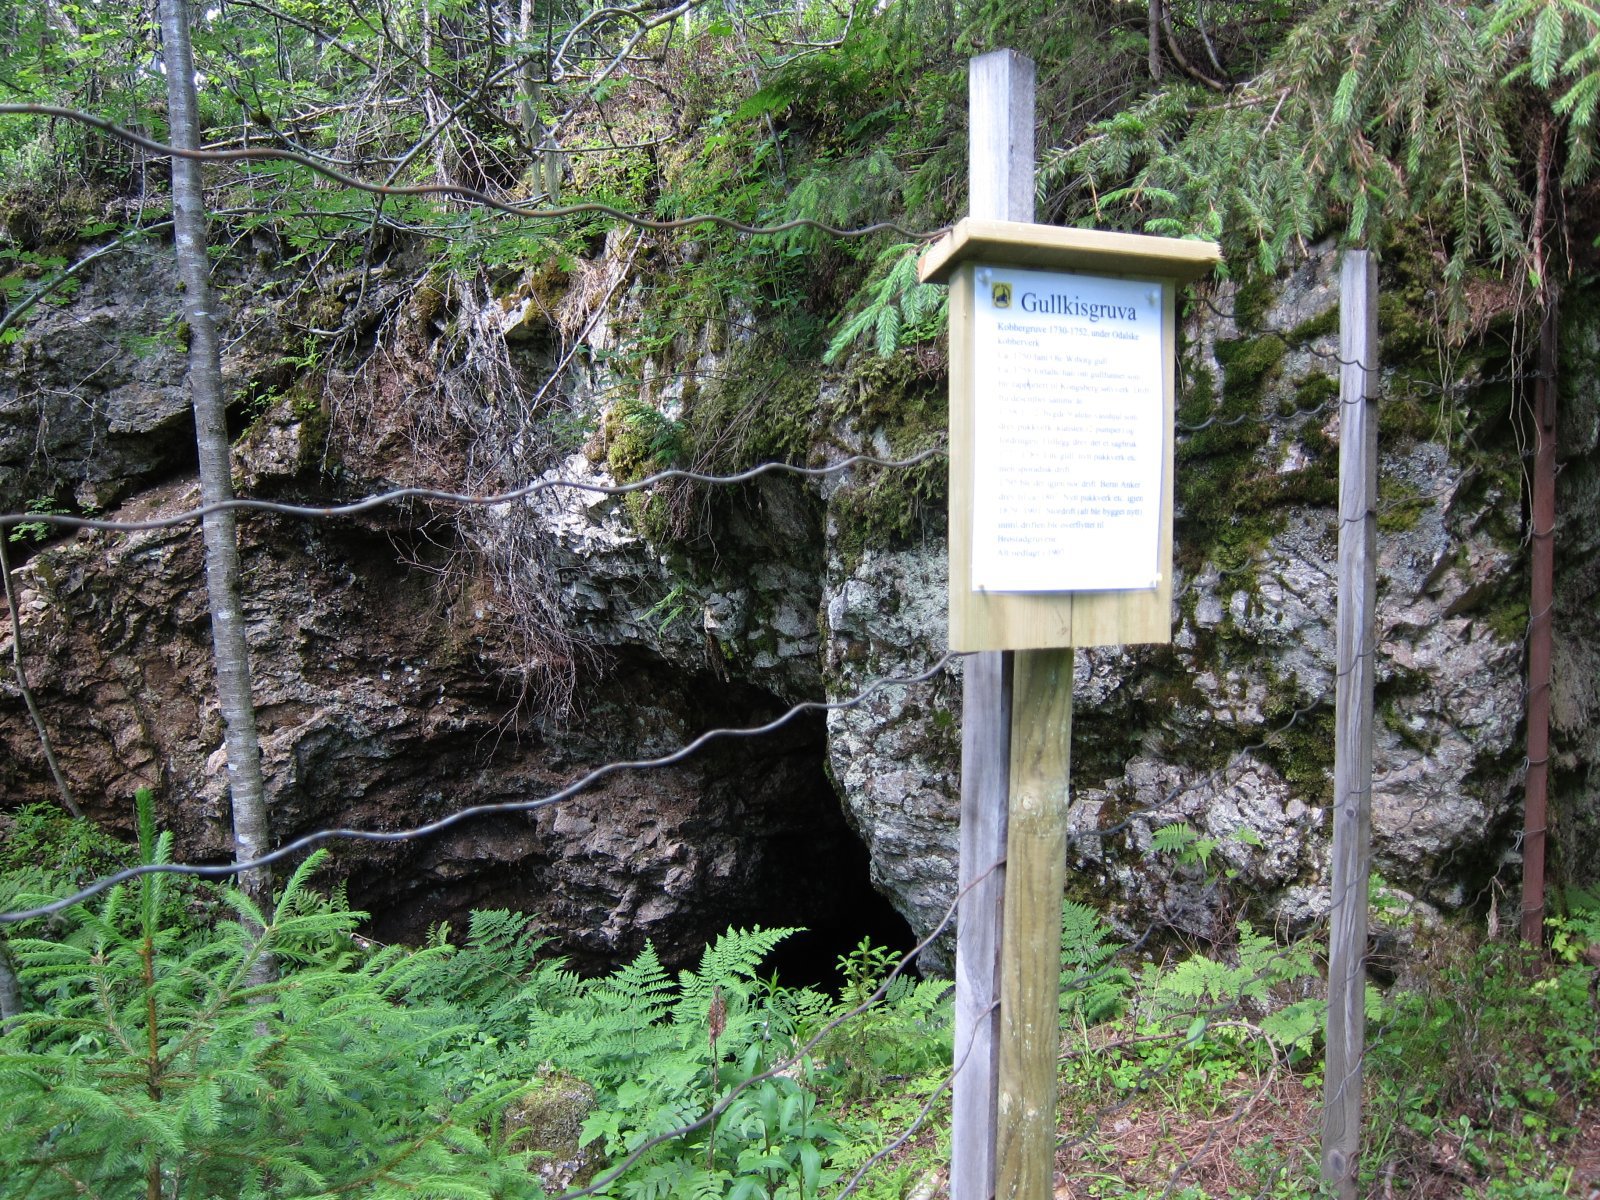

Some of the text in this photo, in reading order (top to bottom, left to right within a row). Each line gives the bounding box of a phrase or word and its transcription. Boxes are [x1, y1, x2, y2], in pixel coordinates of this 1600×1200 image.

[1021, 292, 1138, 323] Gullkisgruva
[997, 321, 1047, 335] Kobbergruve
[1091, 329, 1111, 338] under
[1120, 480, 1141, 489] Anker
